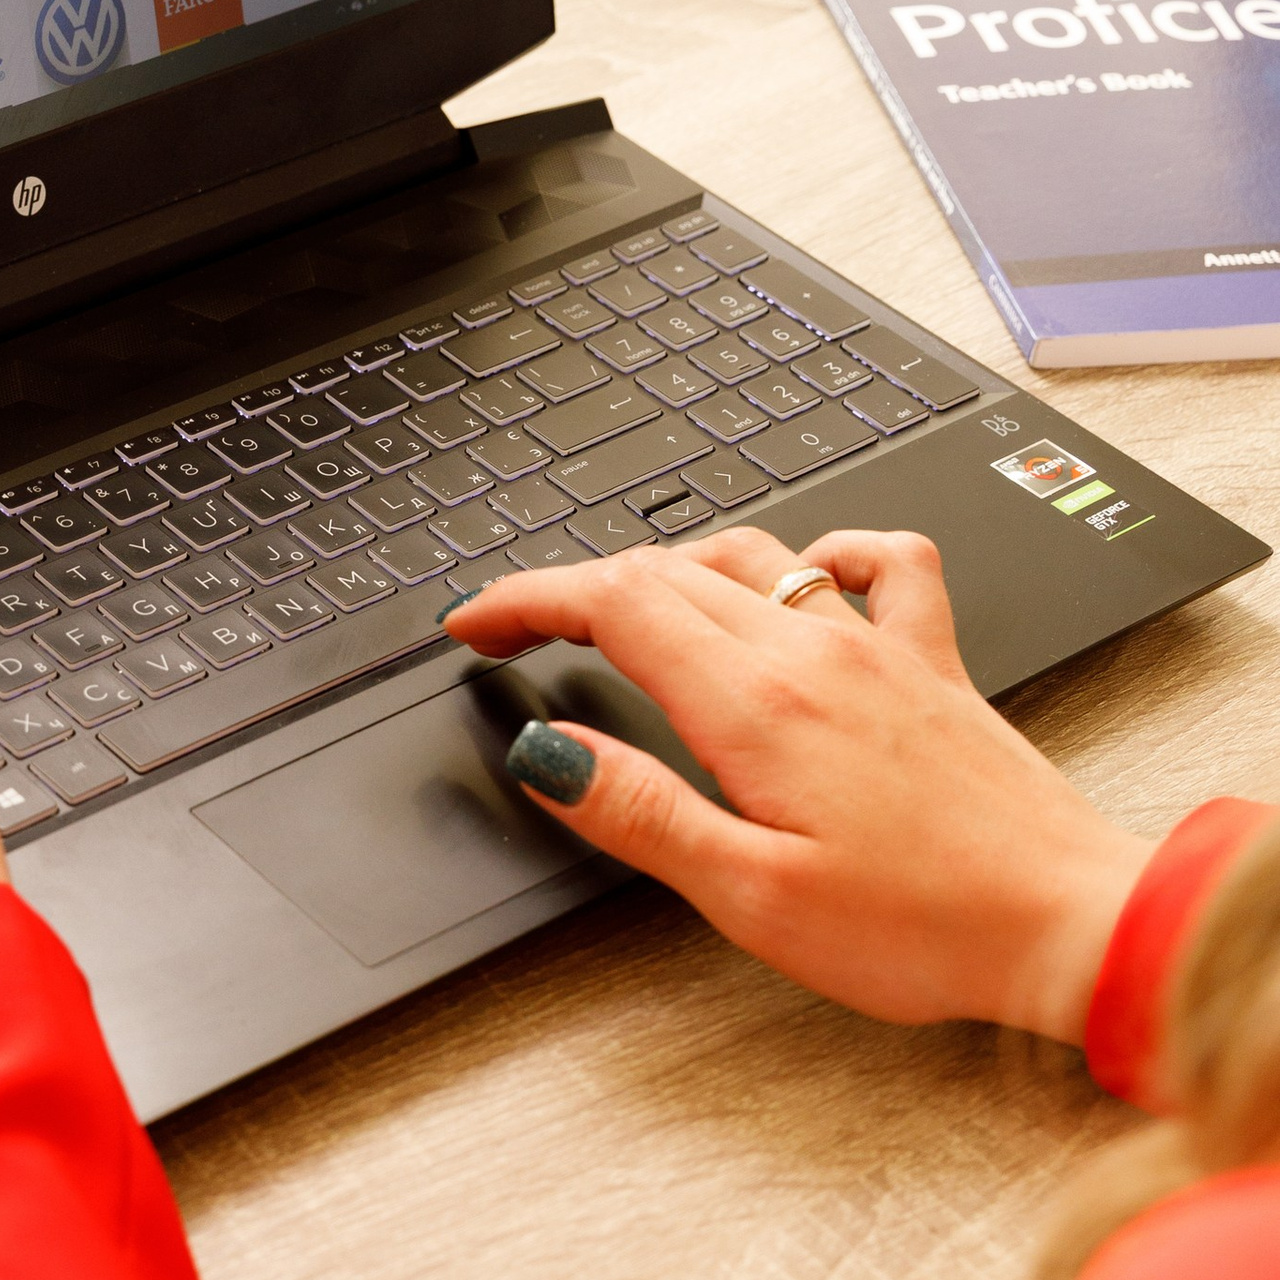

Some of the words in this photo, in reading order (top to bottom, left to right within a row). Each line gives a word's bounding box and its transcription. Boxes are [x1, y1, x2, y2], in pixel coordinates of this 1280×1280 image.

[937, 74, 1097, 104] Teacher's
[1100, 68, 1193, 92] Book
[17, 177, 43, 216] hp
[469, 300, 497, 315] delete
[720, 296, 737, 308] 9
[416, 325, 431, 336] prt
[669, 318, 687, 329] 8
[772, 328, 790, 340] 6
[374, 344, 393, 353] f12
[616, 339, 631, 351] 7
[625, 346, 653, 361] home
[720, 350, 738, 363] 5
[319, 366, 335, 375] f11
[822, 362, 842, 374] 3
[672, 374, 686, 385] 4
[834, 376, 849, 386] pg
[848, 370, 860, 380] dn
[263, 388, 281, 397] f10
[773, 386, 792, 399] 2
[205, 413, 220, 421] f9
[896, 408, 912, 419] del
[734, 418, 752, 430] end
[147, 436, 162, 444] f8
[241, 439, 258, 450] 9
[375, 438, 393, 452] P
[819, 444, 833, 454] ins
[88, 461, 100, 469] f7
[180, 464, 198, 475] 8
[560, 460, 589, 476] pause
[1025, 457, 1067, 480] RYZEN
[27, 485, 42, 493] f6
[117, 488, 131, 501] 7
[380, 497, 404, 510] L
[193, 512, 216, 527] U
[1085, 500, 1130, 525] GEFORCE
[56, 515, 73, 527] 6
[319, 519, 345, 536] K
[1094, 517, 1117, 531] GTX
[129, 539, 151, 553] Y
[267, 546, 280, 561] J
[545, 548, 563, 561] ctrl
[67, 566, 86, 580] T
[337, 571, 366, 589] M
[194, 572, 221, 589] H
[481, 575, 495, 589] alt
[1, 594, 27, 611] R
[133, 600, 156, 615] G
[275, 598, 303, 616] N
[66, 628, 84, 645] F
[212, 628, 238, 644] B
[147, 655, 169, 672] V
[83, 685, 108, 701] C
[14, 713, 41, 732] X
